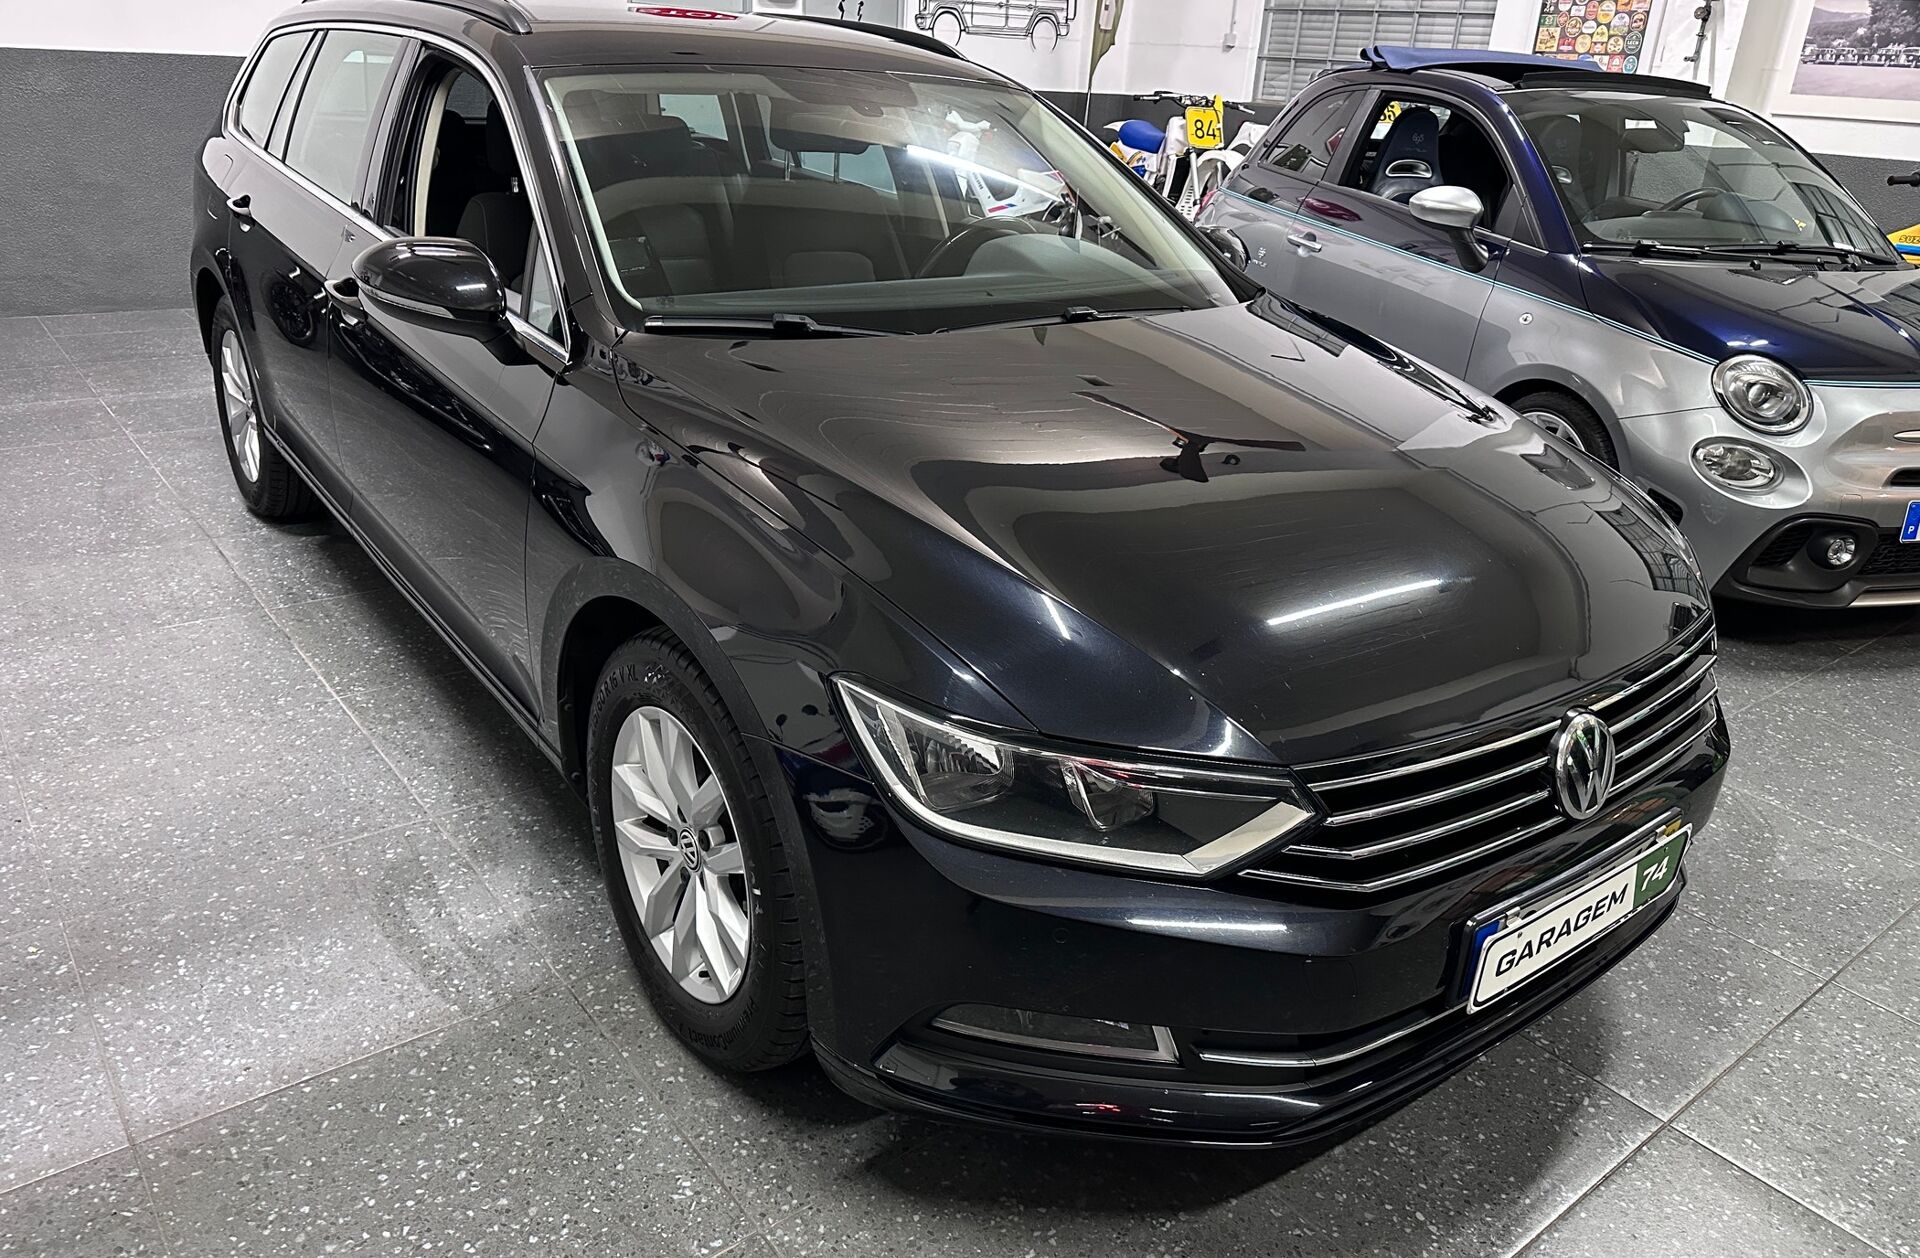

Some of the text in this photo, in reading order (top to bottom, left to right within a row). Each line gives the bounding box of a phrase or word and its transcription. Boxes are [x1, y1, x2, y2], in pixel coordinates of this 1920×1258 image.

[1194, 118, 1217, 140] 84
[1899, 234, 1920, 244] SUZ
[1907, 525, 1915, 534] P
[1494, 855, 1669, 978] GARAGEM 74
